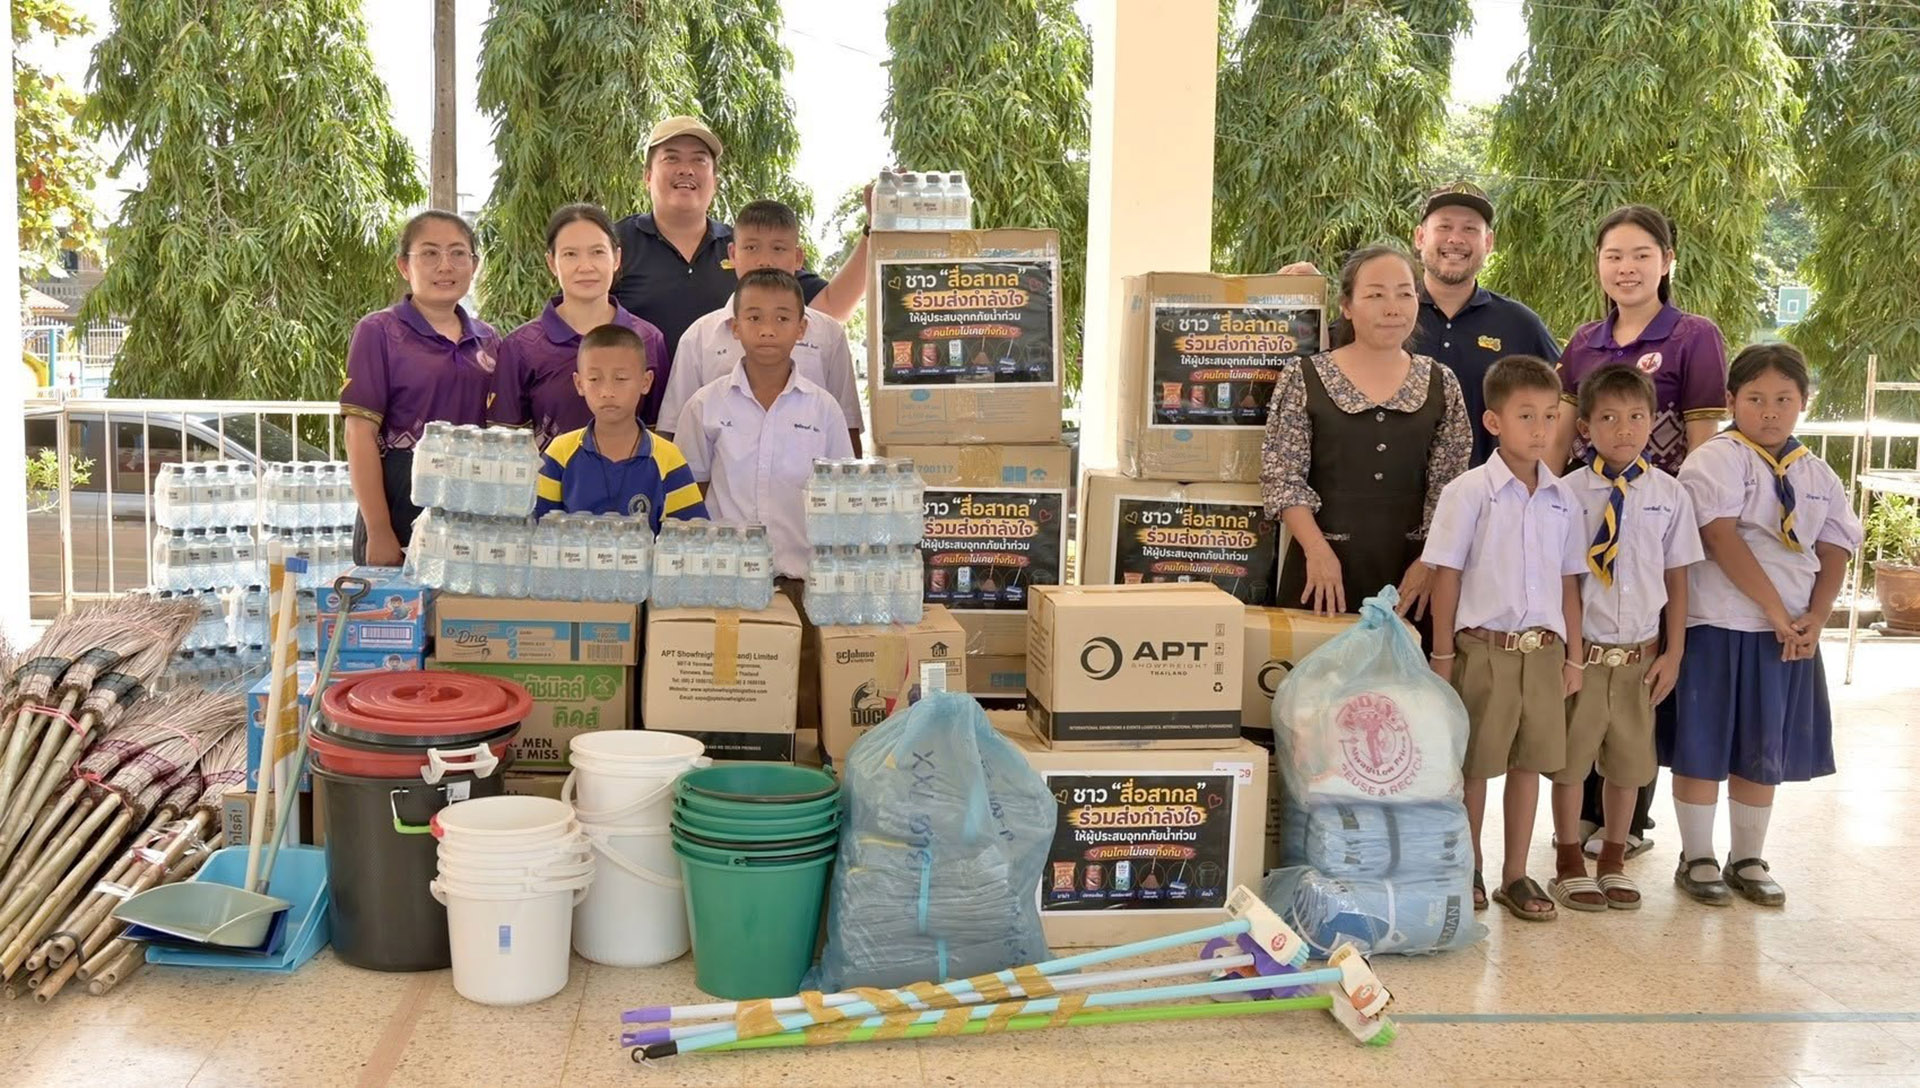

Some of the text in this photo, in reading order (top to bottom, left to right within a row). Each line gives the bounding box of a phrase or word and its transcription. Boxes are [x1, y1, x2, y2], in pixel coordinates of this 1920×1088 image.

[906, 274, 937, 288] ชาว
[912, 288, 1023, 308] ร่วมส่งกำลังใจ
[910, 309, 1021, 325] ให้ผู้ประสบอุทกภัยน้ำท่วม
[933, 325, 1008, 337] คนไทยไม่เคยทิ้งกัน
[1179, 318, 1209, 332] ชาว
[1184, 333, 1293, 352] ร่วมส่งกำลังใจ
[1203, 369, 1275, 381] คนไทยไม่เคยทิ้งกัน
[1142, 510, 1172, 525] ชาว
[925, 517, 1033, 536] ร่วมส่งกำลังใจ
[1147, 526, 1252, 547] ร่วมส่งกำลังใจ
[921, 538, 1029, 552] ให้ผู้ประสบอุทกภัยน้ำท่วม
[943, 553, 1016, 565] คนไทยไม่เคยทิ้งกัน
[1143, 546, 1248, 562] ให้ผู้ประสบอุทกภัยน้ำท่วม
[1164, 562, 1235, 575] คนไทยไม่เคยทิ้งกัน
[455, 630, 488, 644] Dna
[677, 650, 715, 660] Showfreigh
[1132, 642, 1208, 661] APT
[522, 738, 552, 748] MEN
[528, 750, 558, 759] MISS
[1073, 778, 1206, 804] ชาว “สื่อสากล”
[1079, 804, 1201, 826] ร่วมส่งกำลังใจ
[1074, 826, 1197, 845] ให้ผู้ประสบอุทกภัยน้ำท่วม
[1100, 846, 1182, 858] คนไทยไม่เคยทิ้งกัน
